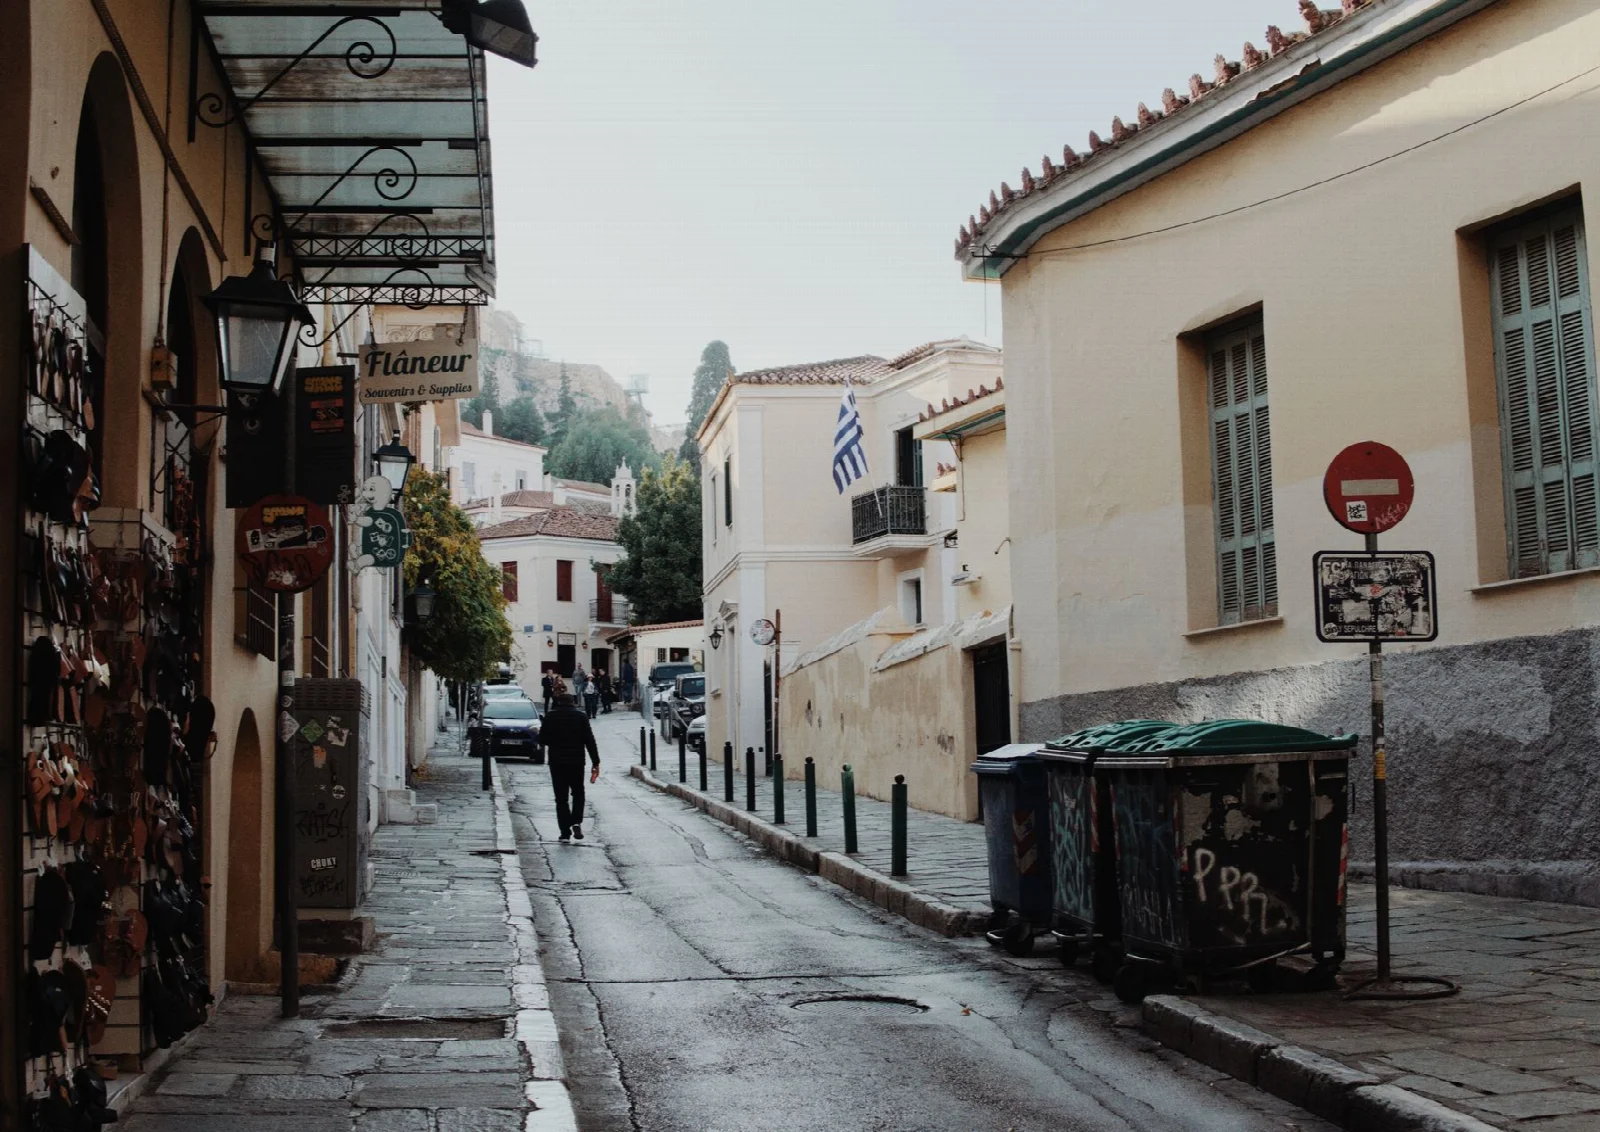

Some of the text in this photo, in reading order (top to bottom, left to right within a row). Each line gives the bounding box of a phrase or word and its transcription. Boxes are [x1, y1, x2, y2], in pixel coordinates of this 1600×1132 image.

[364, 349, 472, 377] Flâneur
[364, 383, 473, 398] Souvenirs & Supplies
